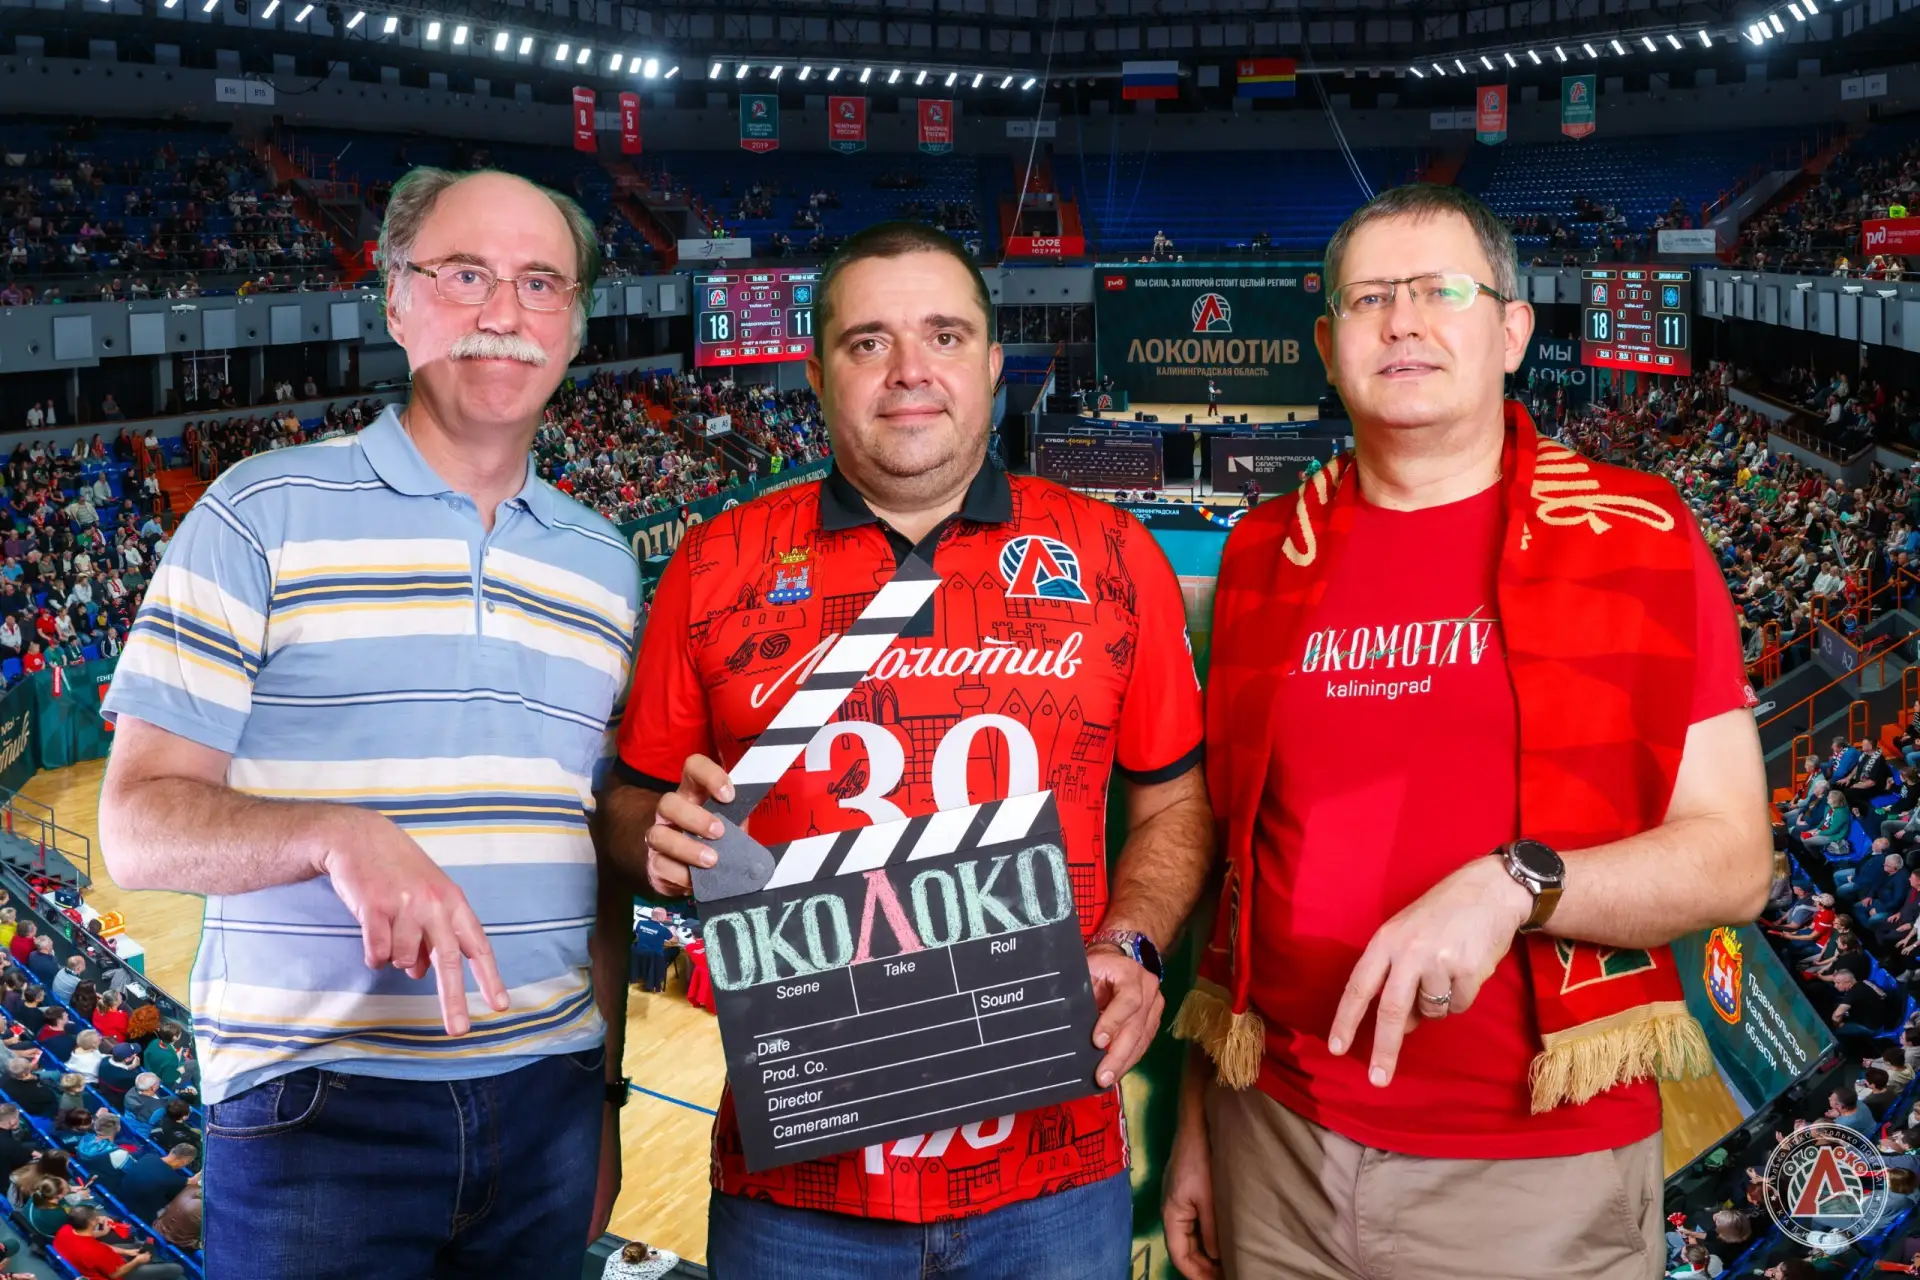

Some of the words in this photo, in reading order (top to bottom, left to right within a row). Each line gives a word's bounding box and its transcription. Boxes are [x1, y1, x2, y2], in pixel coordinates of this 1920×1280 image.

[580, 109, 587, 126] 8
[626, 110, 634, 130] 5
[751, 141, 769, 149] 2019
[840, 142, 856, 150] 2021
[1134, 279, 1148, 287] МЫ
[1149, 279, 1170, 288] СИЛА,
[1171, 279, 1181, 287] ЗА
[1181, 278, 1214, 287] КОТОРОЙ
[1214, 279, 1239, 287] СТОИТ
[1239, 278, 1266, 288] ЦЕЛЫЙ
[1266, 278, 1297, 287] РЕГИОН!
[709, 314, 729, 340] 18
[794, 310, 811, 335] 11
[1592, 312, 1608, 339] 18
[1663, 316, 1679, 345] 11
[1127, 338, 1300, 364] ЛОКОМОТИВ
[1539, 344, 1572, 361] МЫ
[1156, 366, 1233, 376] КАЛИНИНГРАДСКАЯ
[1233, 367, 1269, 377] ОБЛАСТЬ
[1300, 621, 1493, 674] OKOMOTIV
[1822, 634, 1833, 655] A3
[1326, 675, 1432, 700] kaliningrad
[990, 938, 1017, 955] Roll
[883, 960, 916, 977] Take
[776, 980, 820, 1000] Scene
[980, 988, 1025, 1009] Sound
[1748, 972, 1808, 1063] Правительство
[757, 1038, 791, 1056] Date
[1745, 1022, 1778, 1072] области
[762, 1065, 799, 1084] Prod.
[803, 1060, 828, 1075] Co.
[767, 1090, 823, 1112] Director
[773, 1110, 859, 1140] Cameraman
